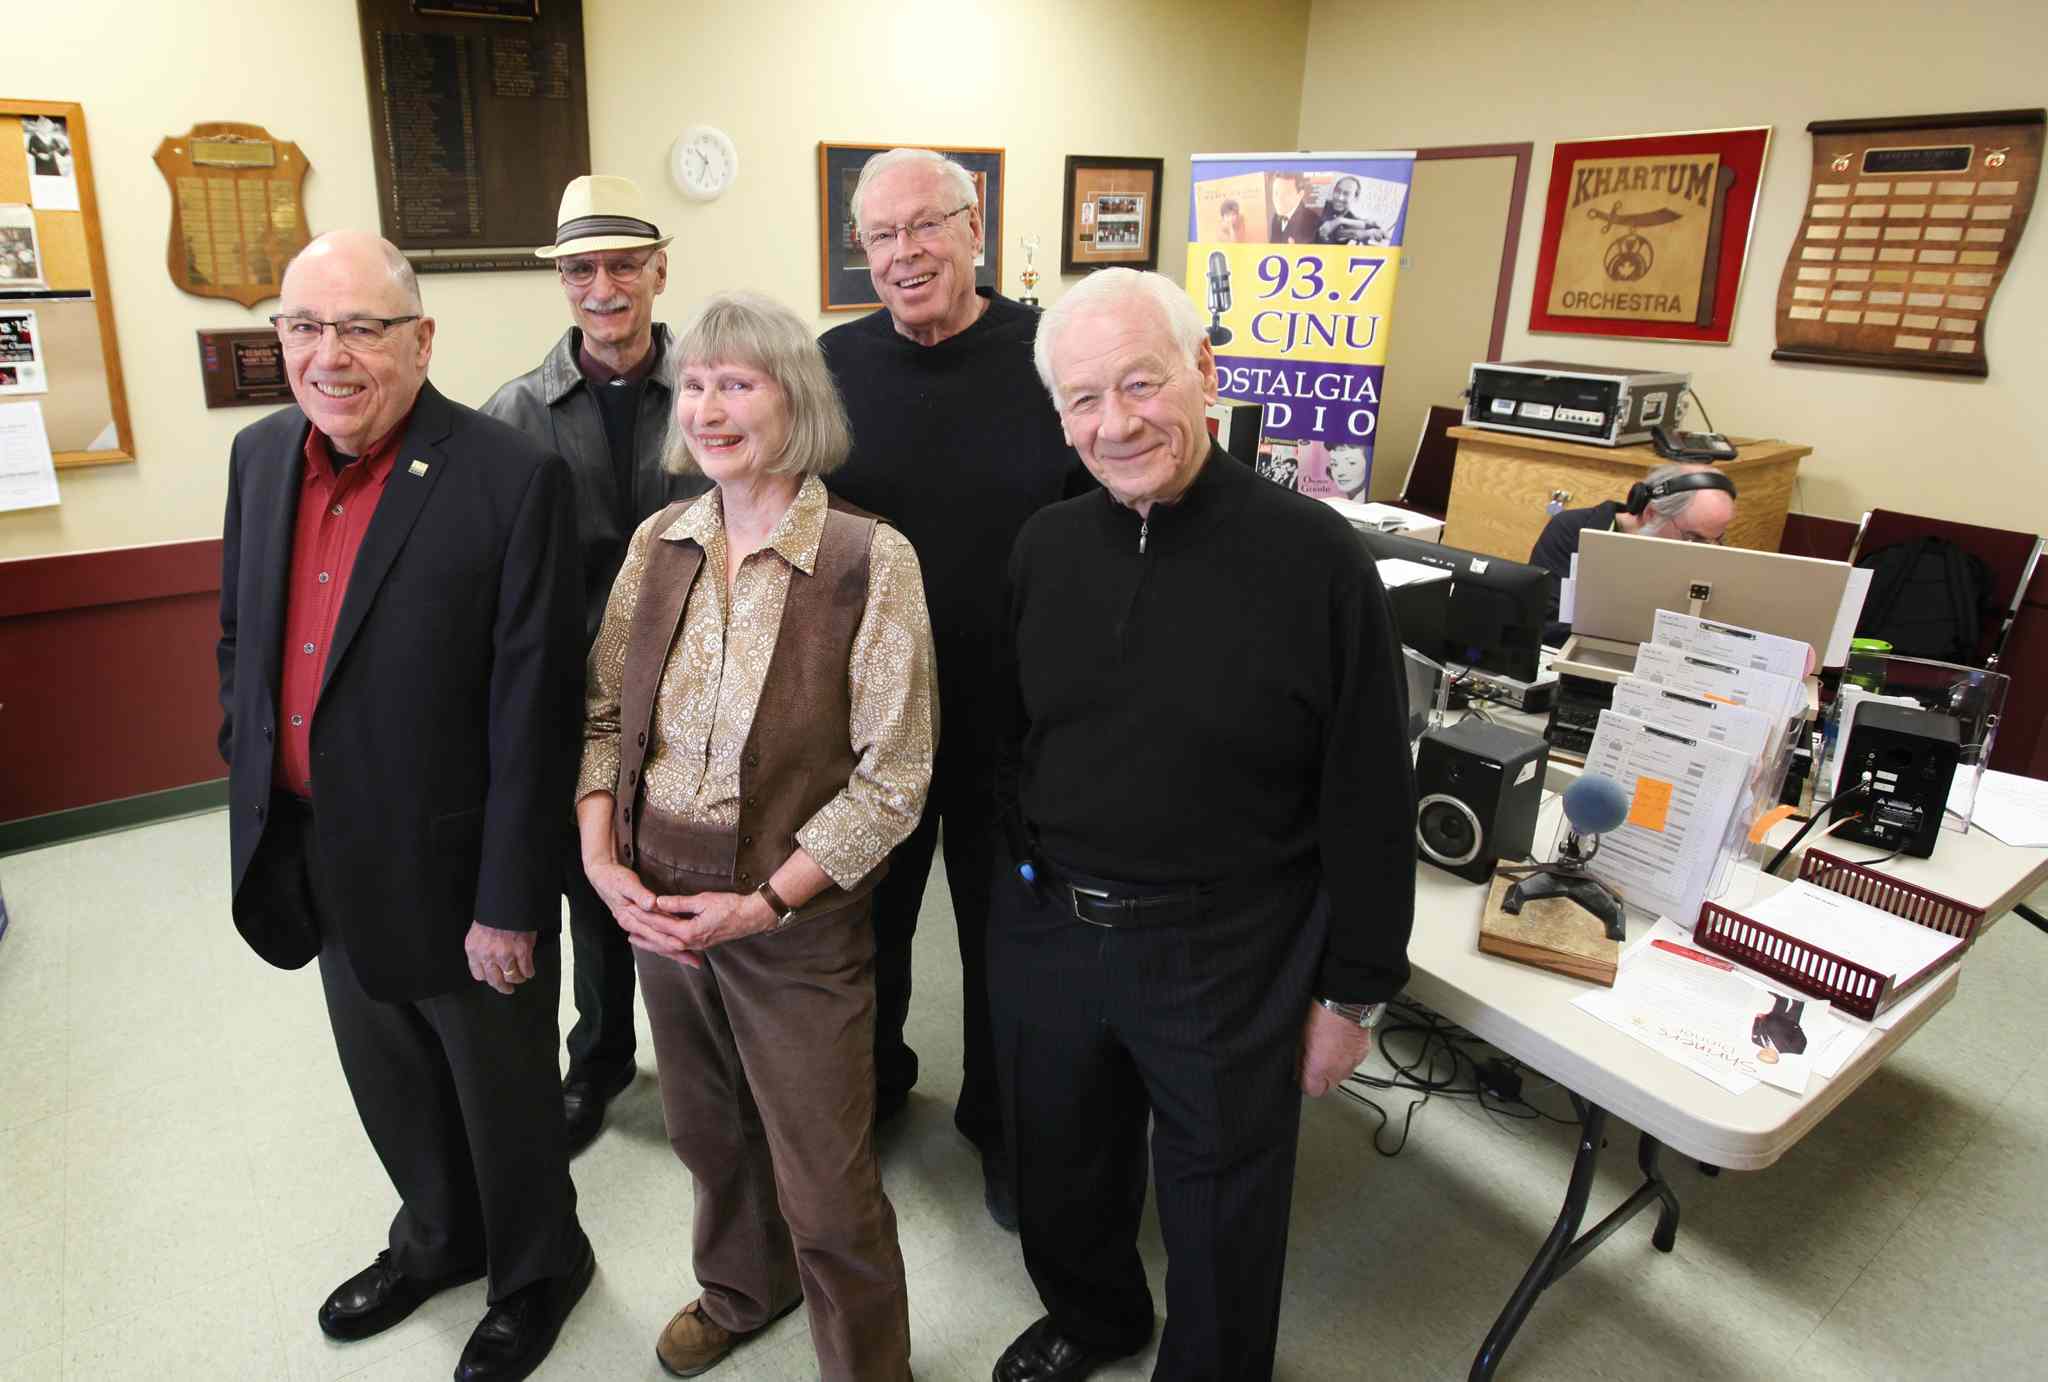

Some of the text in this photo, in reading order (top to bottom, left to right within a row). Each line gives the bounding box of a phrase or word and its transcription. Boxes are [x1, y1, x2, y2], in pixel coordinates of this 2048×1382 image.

[1571, 162, 1714, 208] KHARTUM
[1257, 255, 1385, 301] 93.7
[1562, 290, 1682, 313] ORCHESTRA
[1251, 311, 1379, 353] CJNU
[1214, 366, 1379, 404] OSTALGIA
[1265, 402, 1376, 436] DIO
